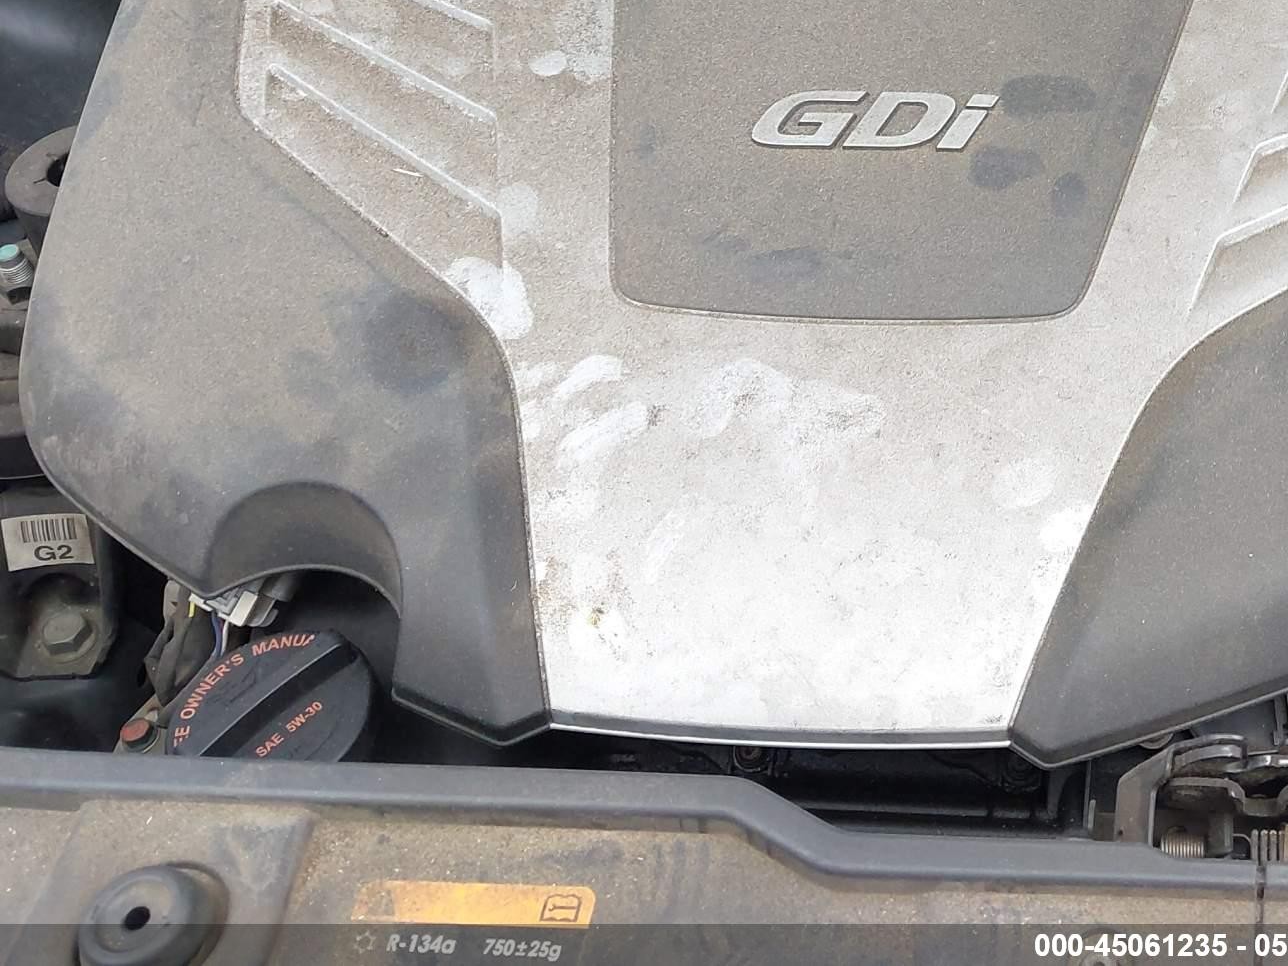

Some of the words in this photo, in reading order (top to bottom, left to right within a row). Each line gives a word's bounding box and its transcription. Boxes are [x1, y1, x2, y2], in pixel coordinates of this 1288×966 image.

[751, 90, 1000, 151] GDi
[34, 544, 75, 562] G2
[180, 653, 245, 720] OWNER'S
[255, 732, 284, 758] SAE
[285, 701, 323, 733] 5W-30
[386, 934, 457, 954] R-134a
[482, 938, 562, 962] 750±25g
